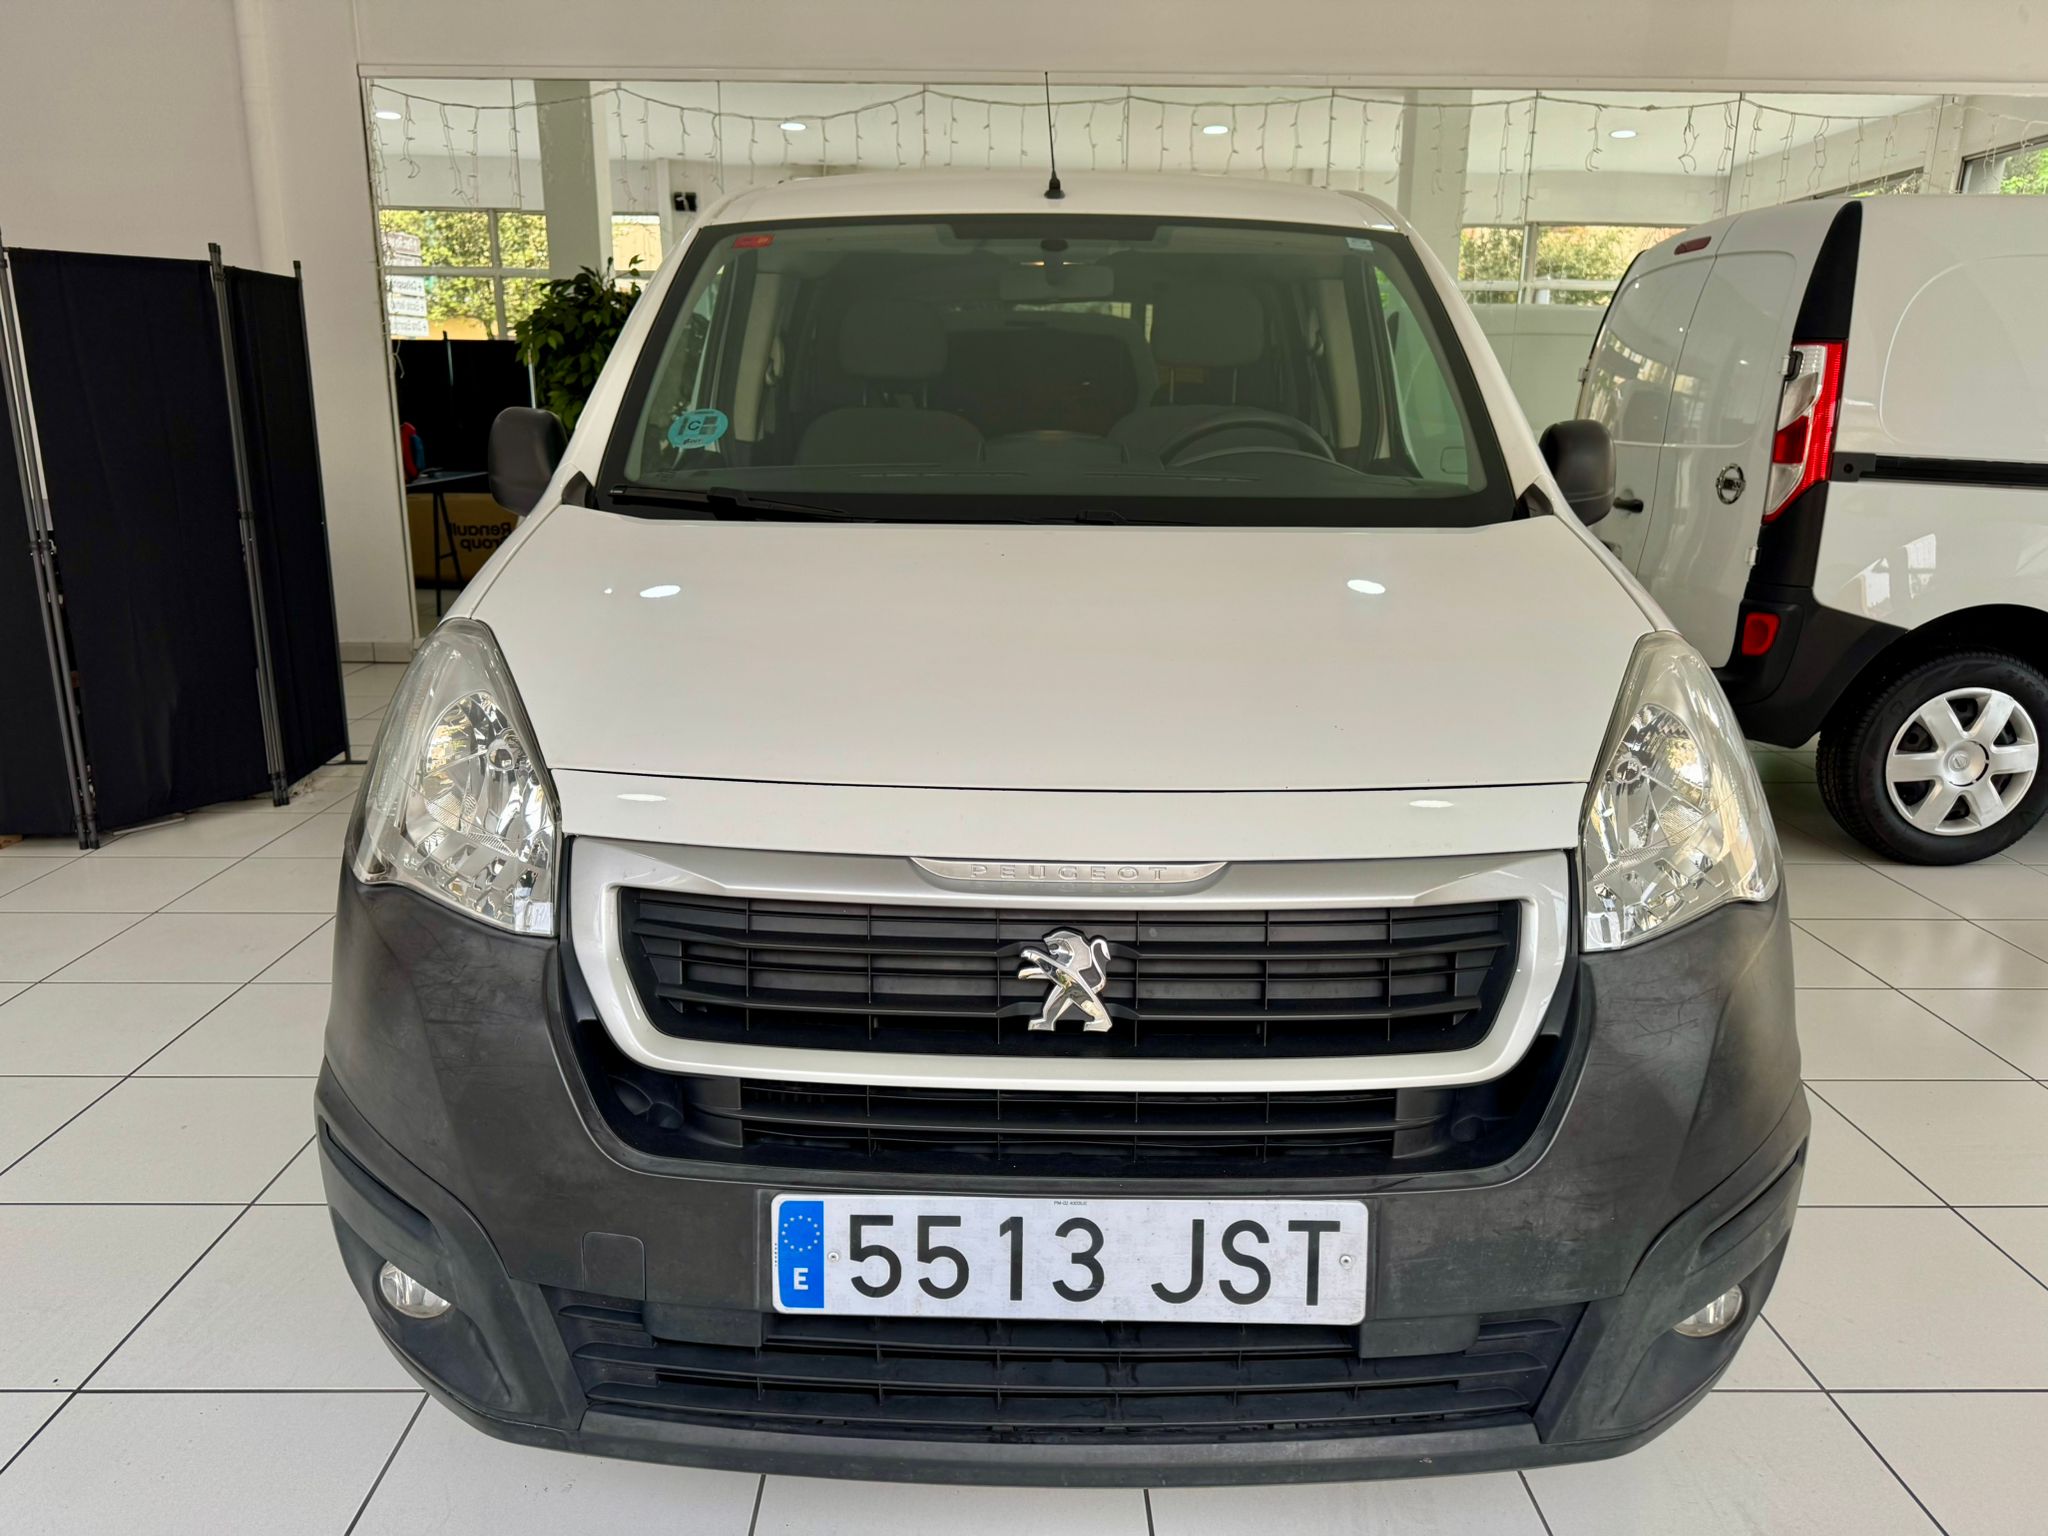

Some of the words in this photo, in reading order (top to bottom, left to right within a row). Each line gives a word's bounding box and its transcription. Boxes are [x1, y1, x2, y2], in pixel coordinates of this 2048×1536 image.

[969, 863, 1167, 881] PEUGEOT
[849, 1214, 1106, 1303] 5513
[1151, 1218, 1341, 1307] JST
[793, 1267, 809, 1290] E
